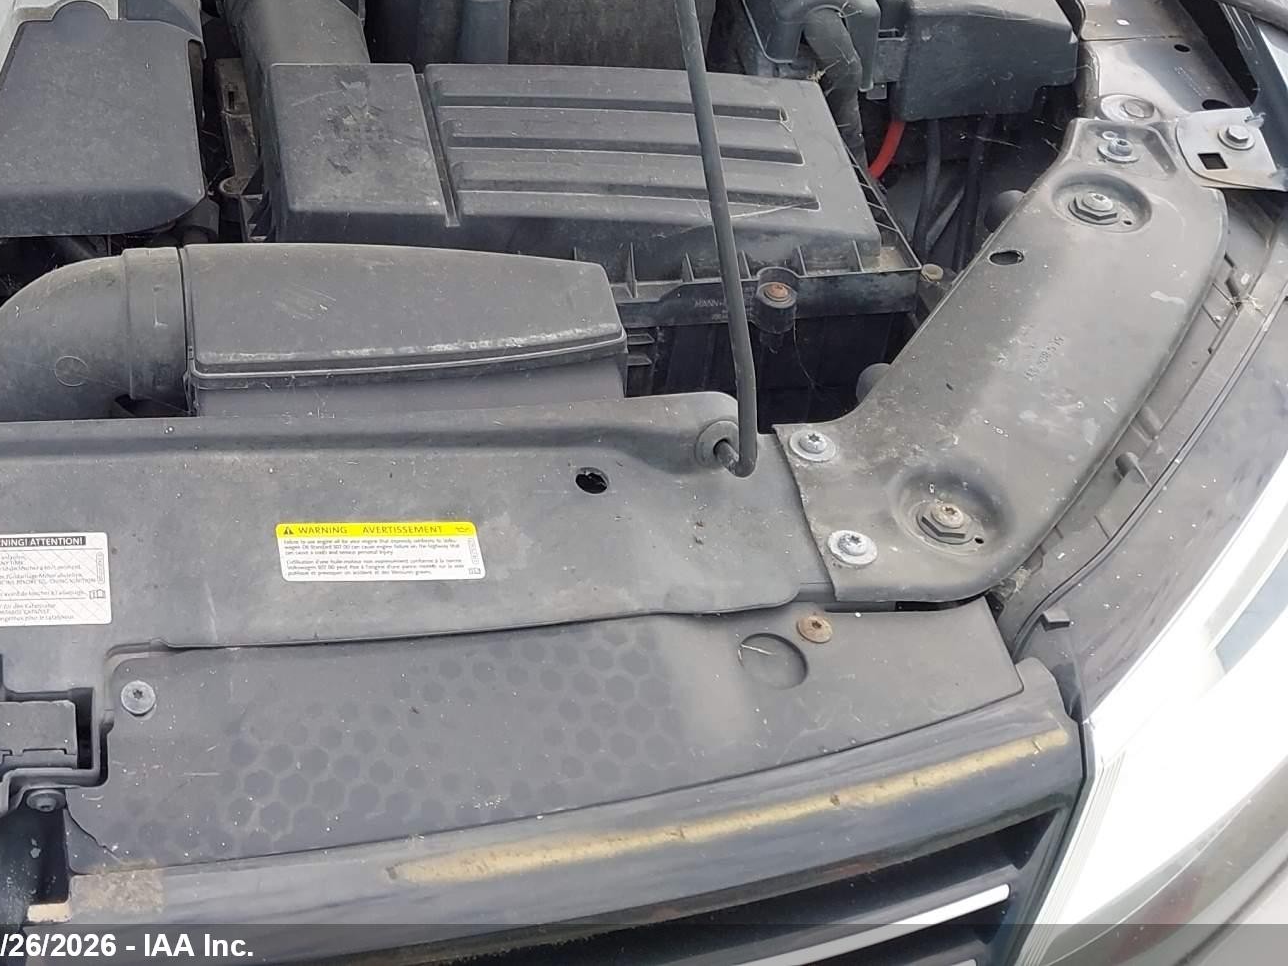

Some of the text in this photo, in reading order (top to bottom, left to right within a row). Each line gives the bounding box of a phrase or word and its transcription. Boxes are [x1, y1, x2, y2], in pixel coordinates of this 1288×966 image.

[298, 525, 442, 534] WARNING AVERTISSEMENT
[30, 536, 83, 546] ATTENTION!
